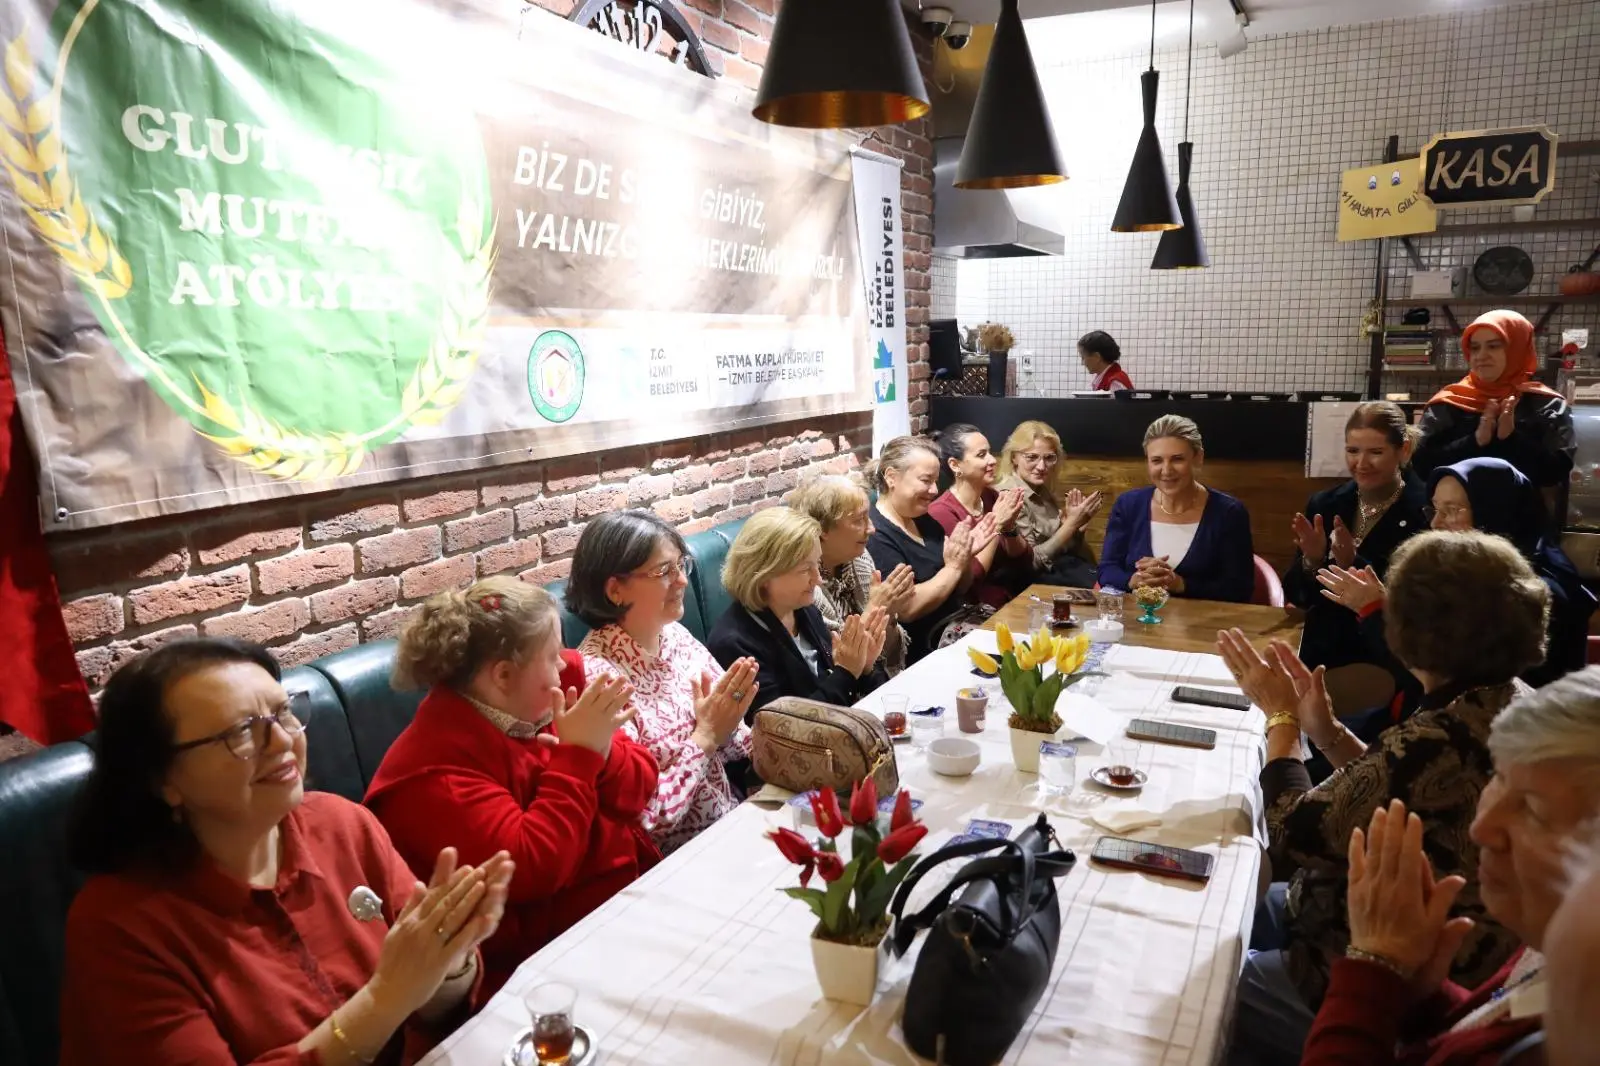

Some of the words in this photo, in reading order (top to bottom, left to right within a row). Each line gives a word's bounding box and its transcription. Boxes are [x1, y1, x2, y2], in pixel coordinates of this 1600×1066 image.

[513, 141, 567, 193] BİZ
[574, 158, 613, 200] DE
[1428, 144, 1541, 191] KASA
[515, 209, 655, 262] YALNIZC
[882, 197, 895, 328] BELEDİYESİ
[875, 261, 883, 328] İZMİT
[650, 347, 667, 361] T.C.
[716, 353, 753, 368] FATMA
